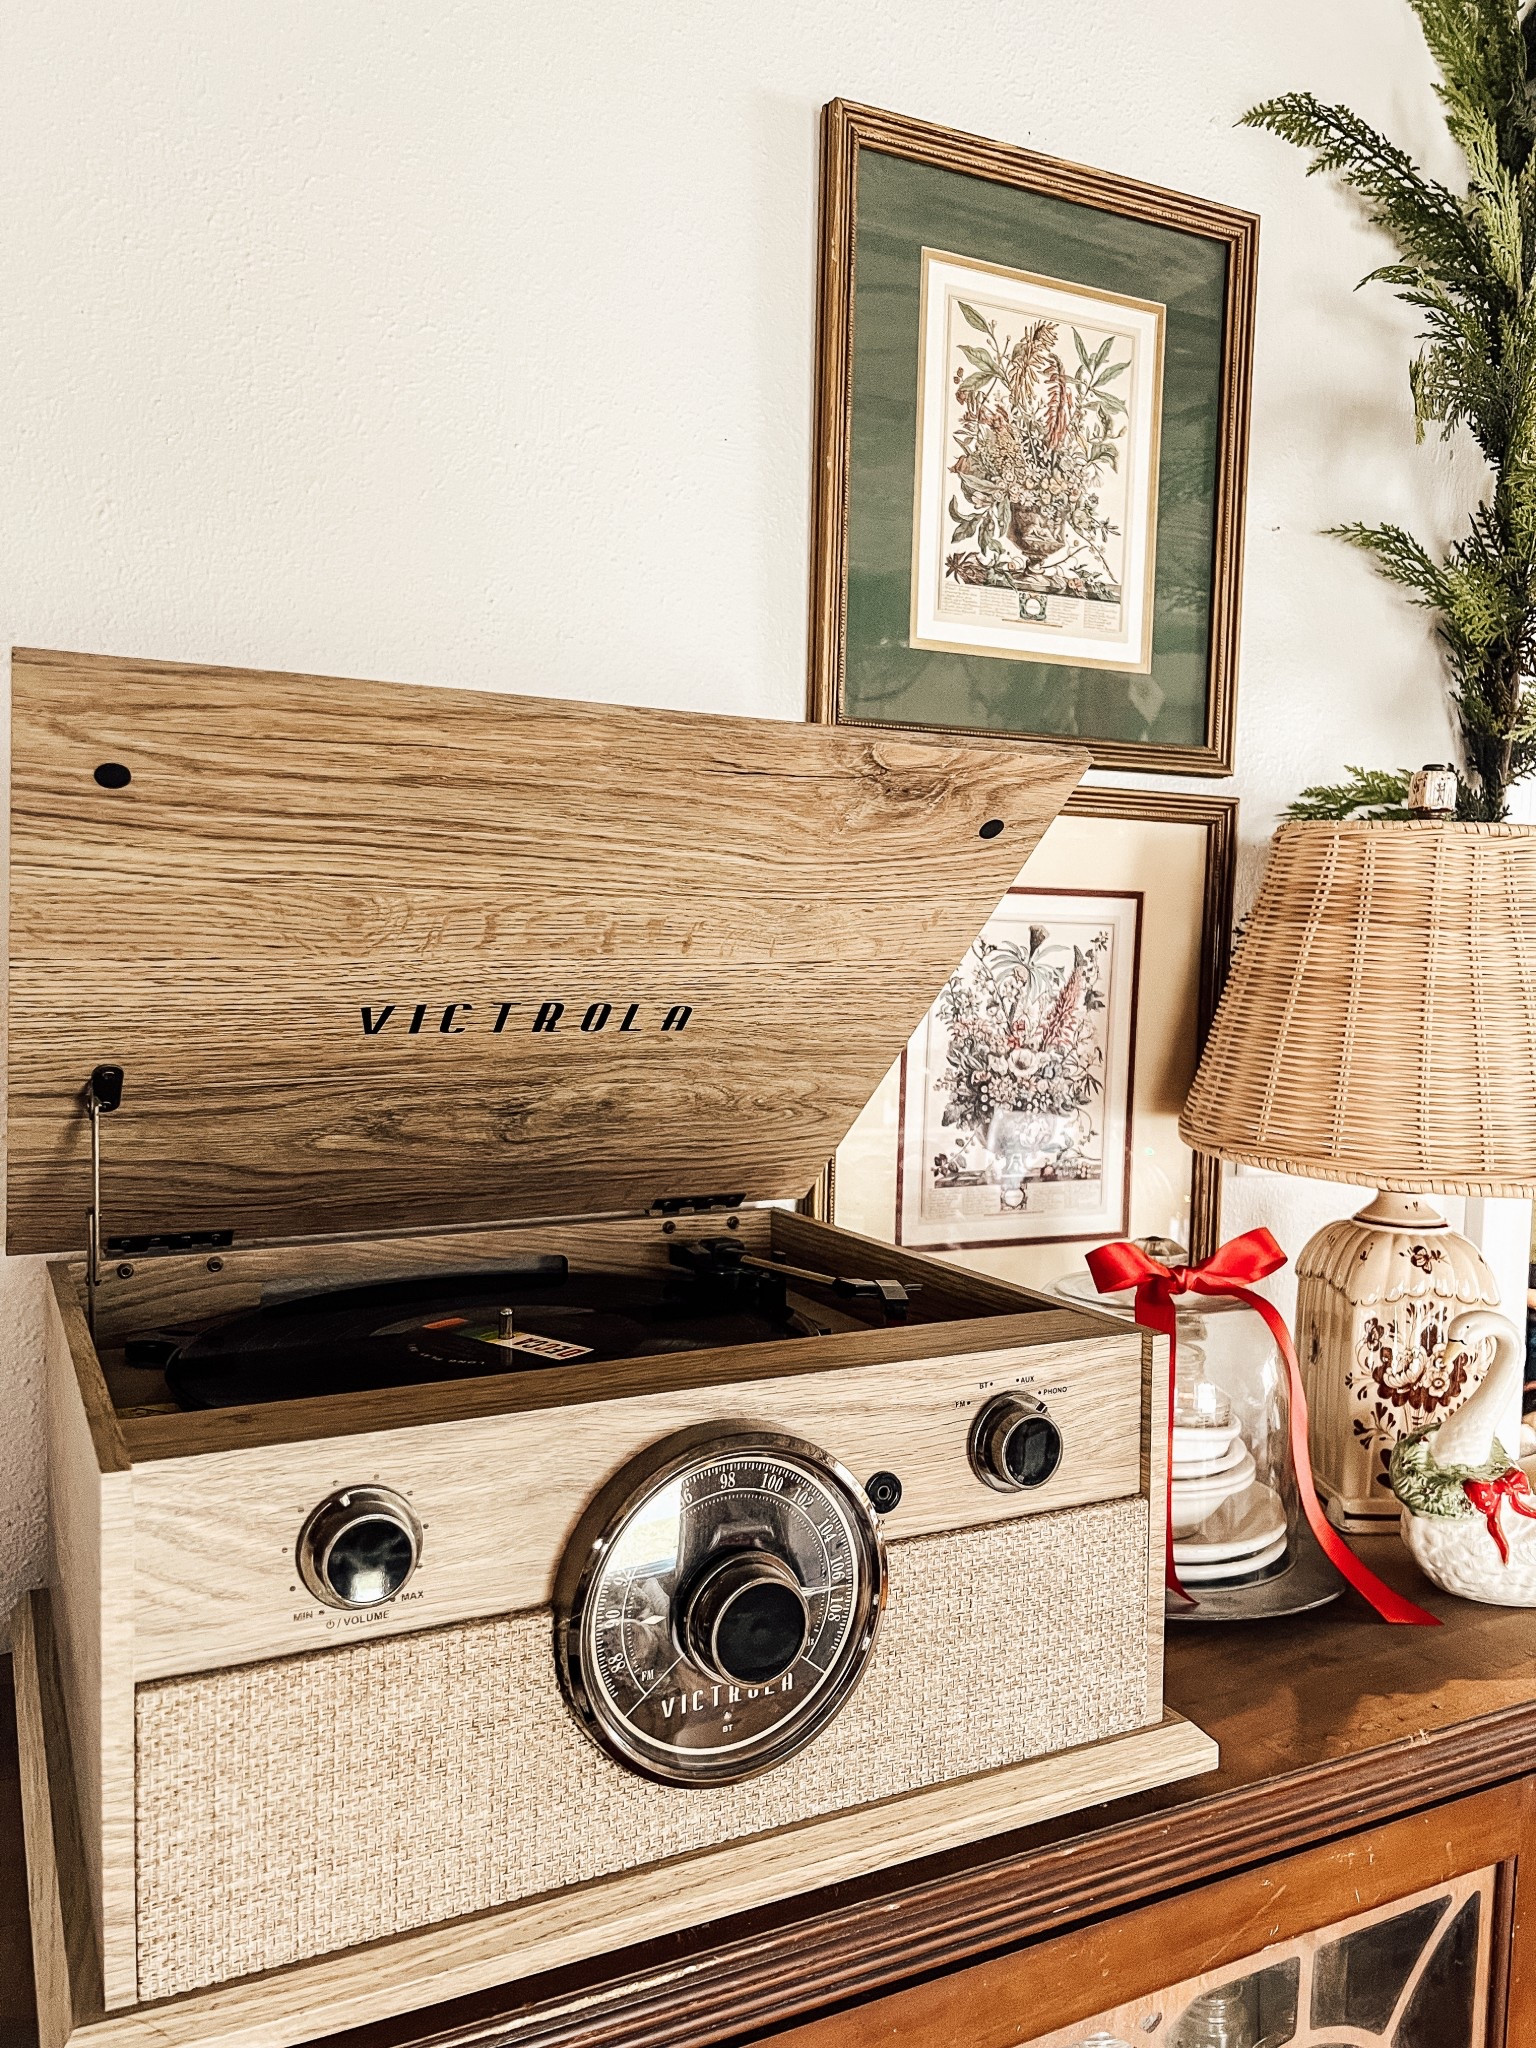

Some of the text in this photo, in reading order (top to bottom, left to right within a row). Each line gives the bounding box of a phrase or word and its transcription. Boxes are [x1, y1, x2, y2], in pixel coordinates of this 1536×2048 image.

[360, 1002, 693, 1035] VICTROLA
[513, 1337, 587, 1358] DECCA
[1043, 1386, 1068, 1395] PHONO
[955, 1400, 966, 1408] FM
[719, 1472, 736, 1489] 98
[760, 1473, 784, 1493] 100
[791, 1487, 815, 1511] 102
[816, 1518, 837, 1544] 104
[830, 1554, 846, 1581] 106
[401, 1590, 424, 1601] MAX
[293, 1610, 313, 1622] MIN
[604, 1609, 621, 1629] 90
[827, 1596, 844, 1622] 108
[608, 1652, 626, 1674] 88
[641, 1668, 655, 1682] FM
[722, 1723, 734, 1733] BT
